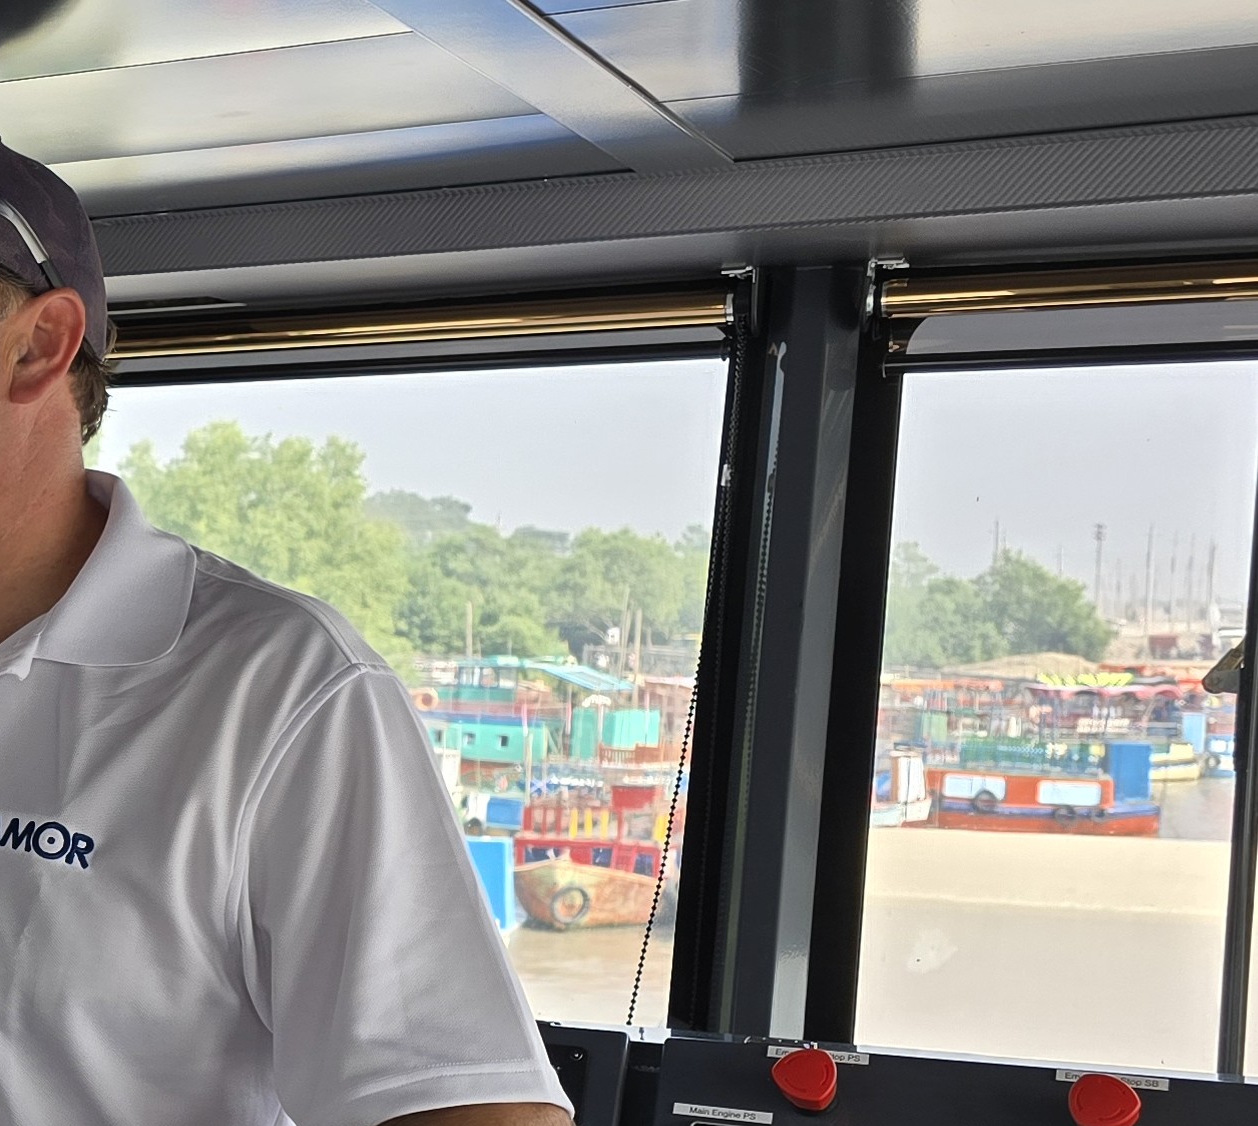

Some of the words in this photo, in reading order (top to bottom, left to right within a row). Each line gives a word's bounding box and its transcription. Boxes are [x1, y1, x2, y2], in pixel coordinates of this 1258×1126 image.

[1064, 1072, 1079, 1081] Em
[1144, 1079, 1159, 1088] SB
[690, 1107, 709, 1116] Main
[712, 1110, 740, 1120] Engine
